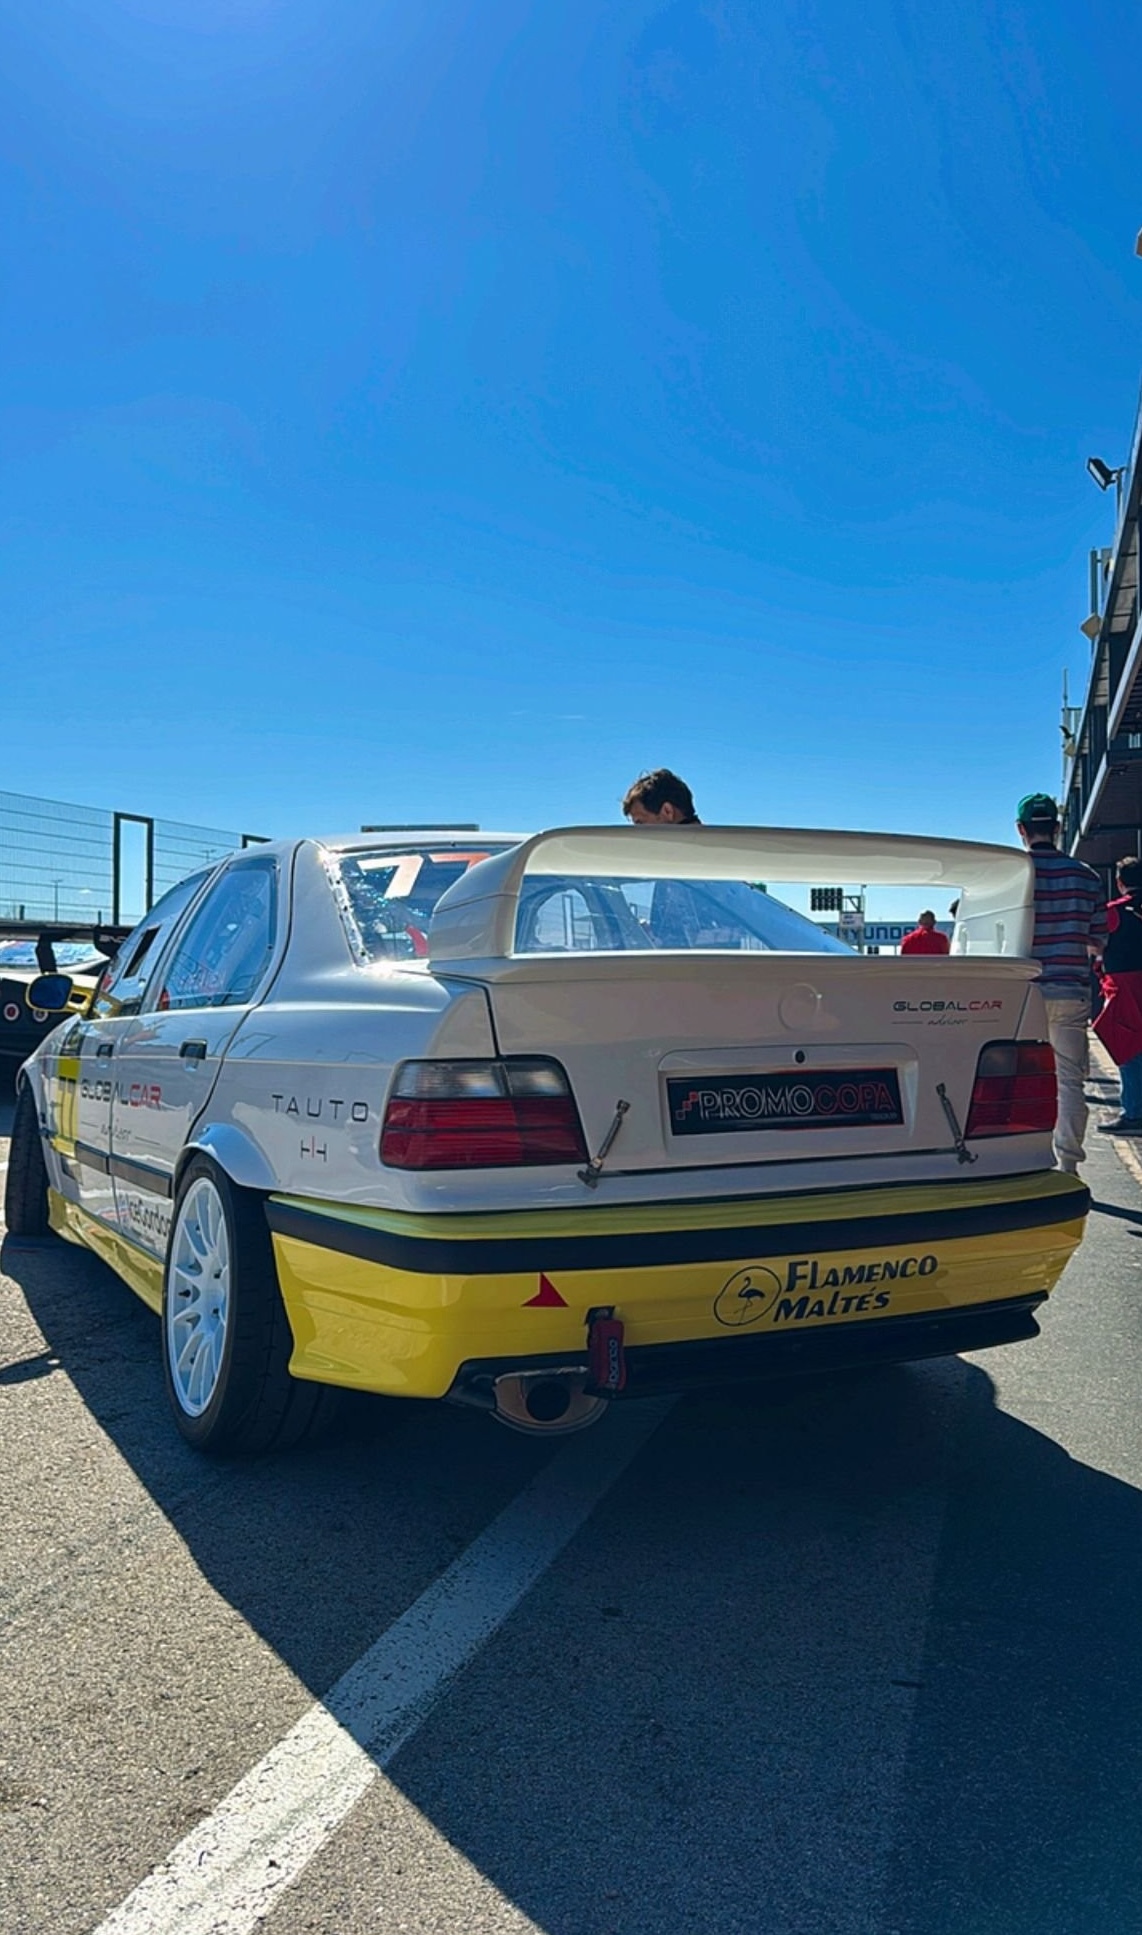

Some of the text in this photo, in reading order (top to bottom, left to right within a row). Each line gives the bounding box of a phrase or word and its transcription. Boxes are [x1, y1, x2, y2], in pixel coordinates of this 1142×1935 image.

[892, 1000, 1003, 1012] GLOBALCAR
[272, 1094, 369, 1122] TAUTO
[699, 1082, 896, 1119] PROMOCOPA
[784, 1255, 938, 1293] FLAMENCO
[773, 1286, 890, 1322] MALTÉS
